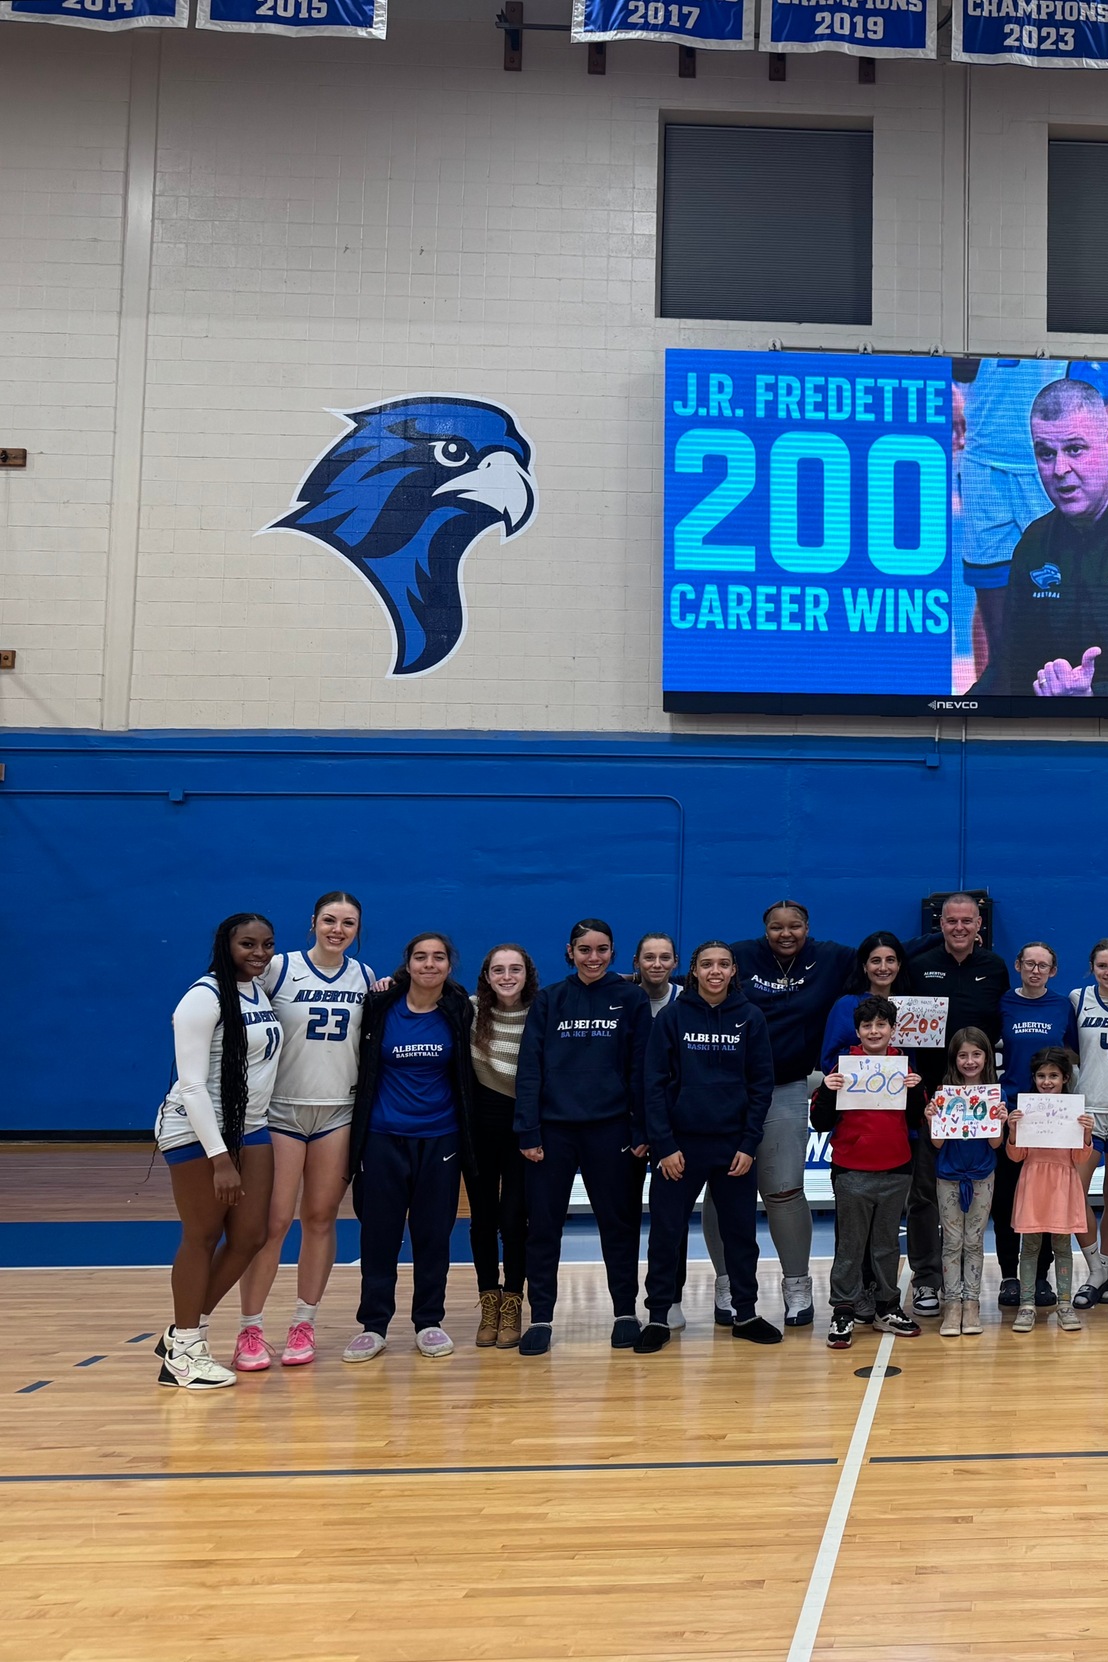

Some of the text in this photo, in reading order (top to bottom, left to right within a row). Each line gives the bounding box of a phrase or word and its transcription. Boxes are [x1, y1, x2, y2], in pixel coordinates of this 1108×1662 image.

[255, 0, 328, 18] 2015
[627, 0, 700, 29] 2017
[815, 12, 884, 40] 2019
[1003, 24, 1075, 51] 2023
[673, 372, 946, 423] J.R. FREDETTE
[674, 428, 947, 576] 200
[670, 583, 949, 634] CAREER WINS
[937, 701, 979, 710] NEVCO
[290, 990, 364, 1004] ALBERTUS
[306, 1007, 350, 1041] 23
[899, 1012, 939, 1034] 200
[1012, 1021, 1052, 1030] ALBERTUS
[392, 1044, 443, 1053] ALBERTUS
[847, 1071, 905, 1095] 200
